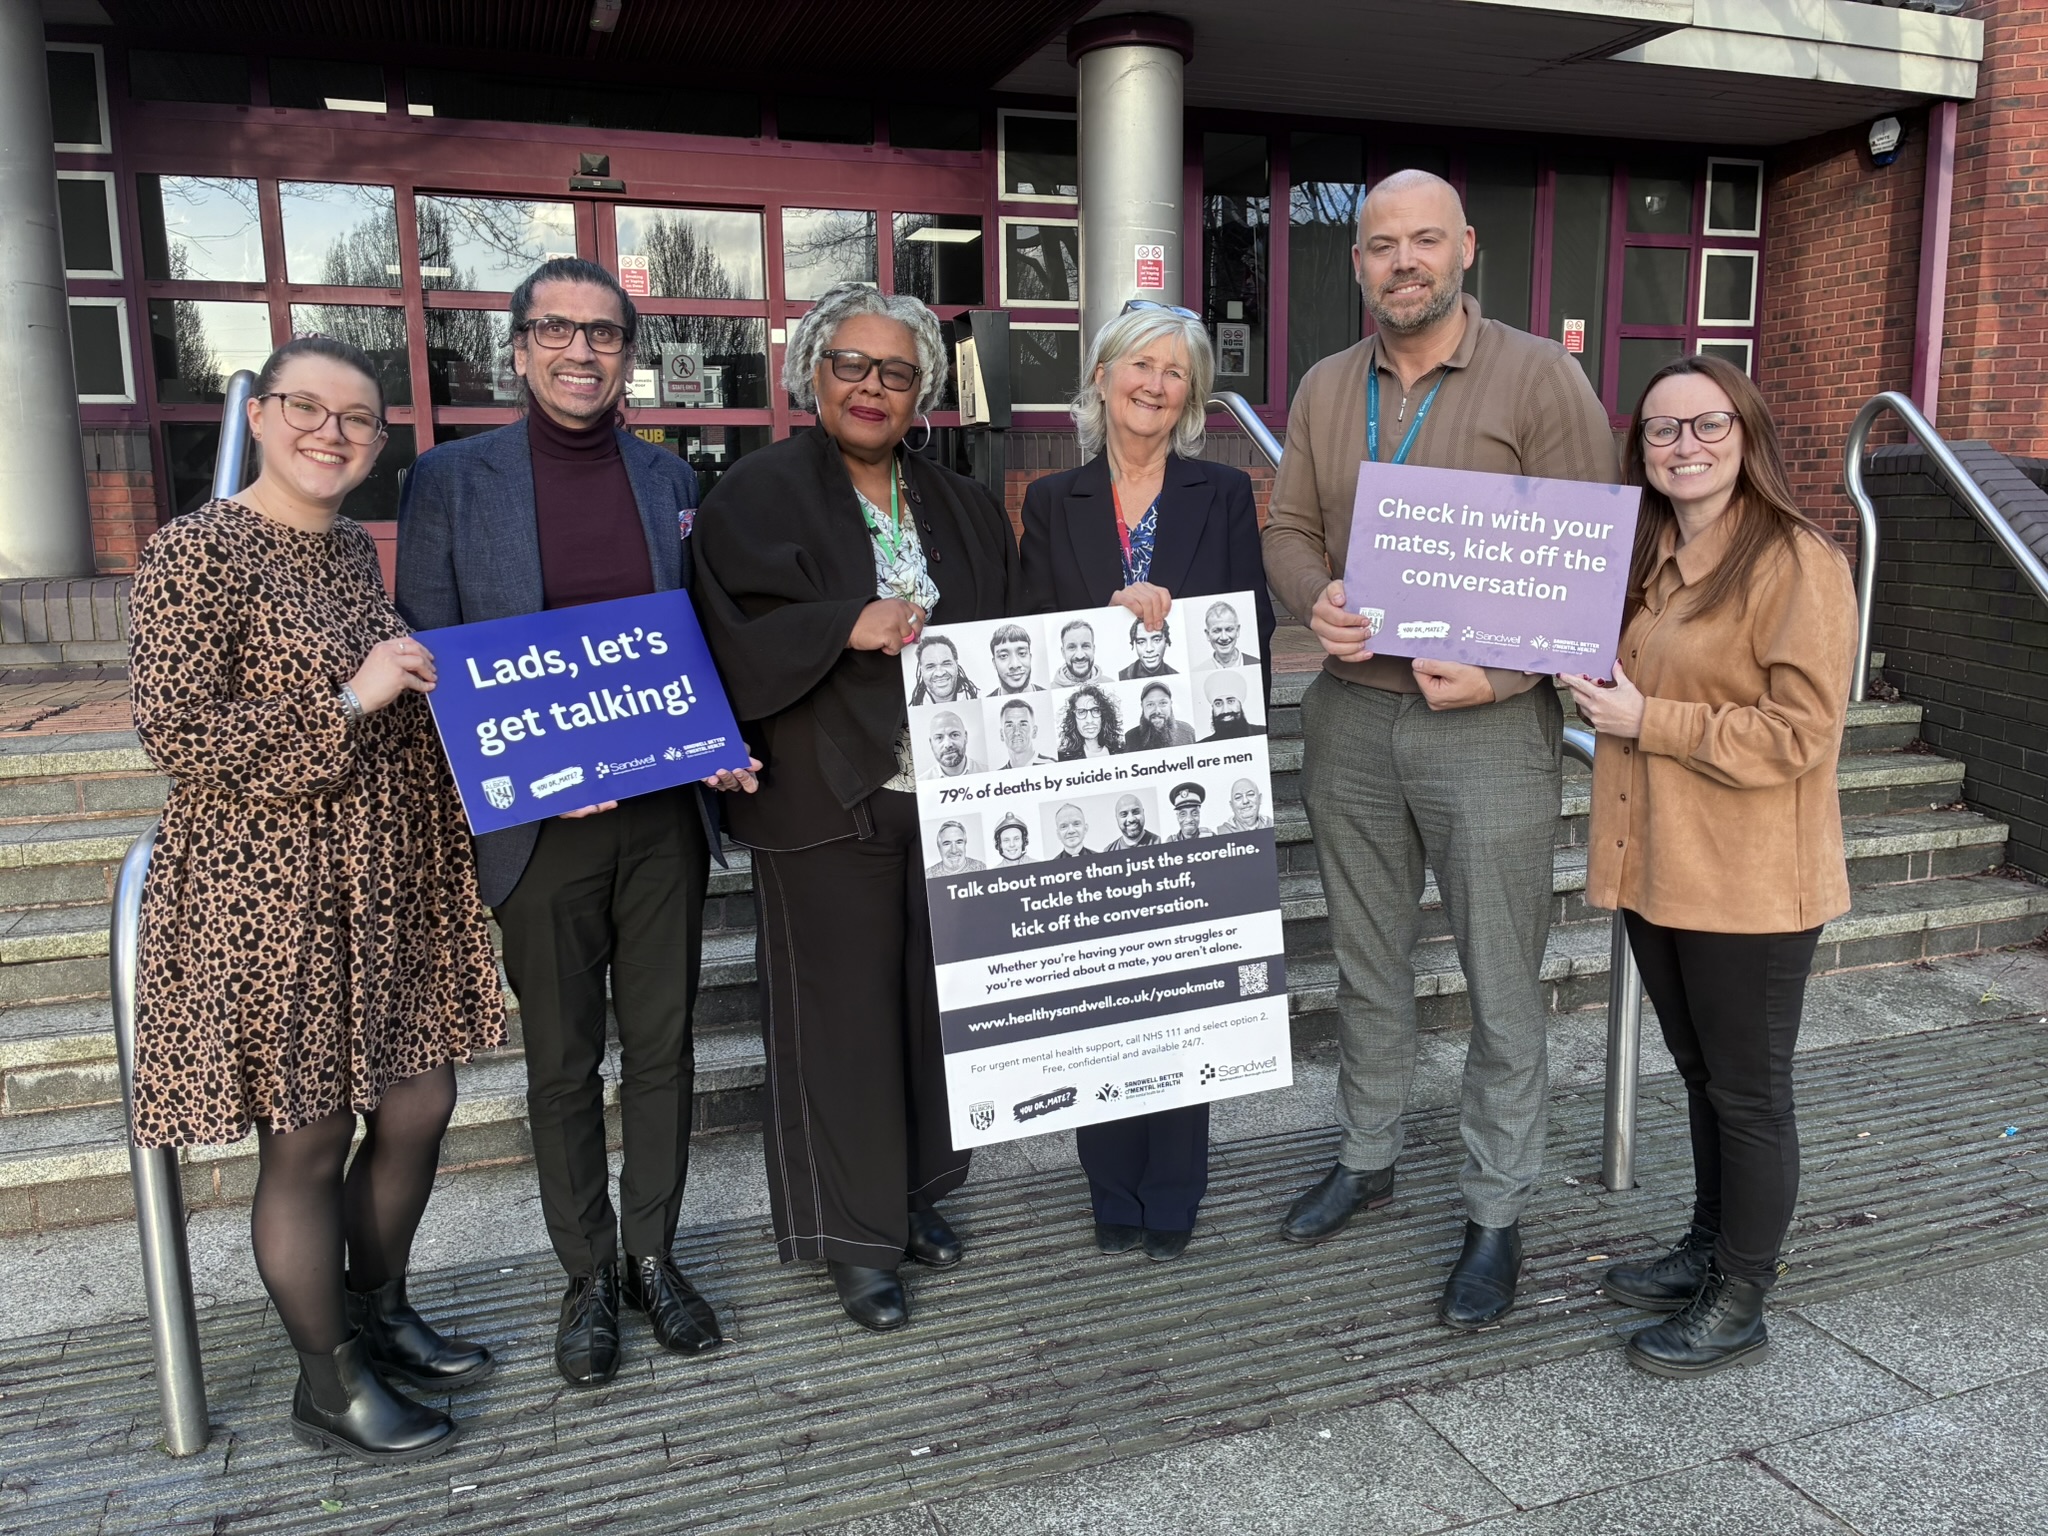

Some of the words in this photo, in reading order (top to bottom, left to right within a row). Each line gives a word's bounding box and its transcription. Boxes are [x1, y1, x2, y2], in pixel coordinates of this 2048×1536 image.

[1378, 497, 1456, 524] Check
[1460, 504, 1484, 527] in
[1491, 509, 1546, 534] with
[1550, 519, 1614, 541] your
[1373, 533, 1456, 561] mates,
[1463, 537, 1514, 563] kick
[1519, 544, 1560, 567] off
[1563, 548, 1607, 573] the
[1401, 568, 1568, 602] conversation
[1475, 630, 1521, 644] Sandwell
[466, 644, 579, 689] Lads,
[581, 627, 668, 667] let's
[476, 708, 547, 757] get
[548, 674, 697, 731] talking!
[609, 754, 656, 772] Sandwell
[939, 786, 974, 804] 79%
[976, 783, 991, 799] of
[993, 778, 1042, 797] deaths
[1043, 775, 1063, 792] by
[1065, 767, 1113, 787] suicide
[1114, 766, 1129, 780] in
[1130, 755, 1195, 778] Sandwell
[1196, 757, 1221, 769] are
[1223, 752, 1253, 765] men
[946, 880, 985, 900] Talk
[987, 874, 1037, 894] about
[1039, 870, 1083, 886] more
[1085, 862, 1123, 879] than
[1125, 856, 1156, 877] just
[1157, 851, 1184, 868] the
[1186, 842, 1260, 864] scoreline.
[1020, 891, 1073, 912] Tackle
[1076, 887, 1103, 904] the
[1105, 878, 1153, 899] tough
[1156, 871, 1196, 892] stuff,
[1011, 919, 1045, 938] kick
[1048, 913, 1071, 932] off
[1073, 911, 1100, 928] the
[1103, 896, 1209, 923] conversation.
[985, 977, 1023, 995] you're
[1024, 967, 1071, 985] worried
[1072, 963, 1106, 977] about
[1107, 963, 1116, 971] a
[1117, 957, 1150, 969] mate,
[1151, 953, 1173, 967] you
[1174, 945, 1207, 960] aren't
[1208, 942, 1242, 954] alone.
[987, 959, 1038, 976] Whether
[1039, 952, 1076, 970] you're
[1078, 946, 1117, 961] having
[1119, 942, 1145, 957] your
[1147, 938, 1172, 949] own
[1174, 928, 1224, 945] struggles
[1225, 927, 1238, 936] or
[967, 979, 1225, 1032] www.healthysandwell.co.uk/youokmate
[970, 1064, 987, 1074] For
[988, 1058, 1020, 1071] urgent
[1021, 1049, 1054, 1065] mental
[1055, 1045, 1084, 1058] health
[1085, 1039, 1124, 1053] support,
[1125, 1033, 1141, 1046] call
[1142, 1030, 1164, 1042] NHS
[1165, 1027, 1181, 1038] 111
[1183, 1023, 1201, 1035] and
[1202, 1020, 1228, 1032] select
[1229, 1015, 1259, 1028] option
[1260, 1011, 1269, 1021] 2.
[1042, 1064, 1066, 1075] Free,
[1067, 1051, 1120, 1070] confidential
[1122, 1048, 1140, 1060] and
[1141, 1041, 1180, 1056] available
[1181, 1037, 1205, 1049] 24/7.
[1124, 1077, 1158, 1088] SANDWELL
[1159, 1071, 1184, 1082] BETTER
[1157, 1079, 1181, 1089] HEALTH
[1218, 1056, 1277, 1077] Sandwell
[1020, 1104, 1033, 1115] YOU
[1047, 1092, 1071, 1106] MATE?
